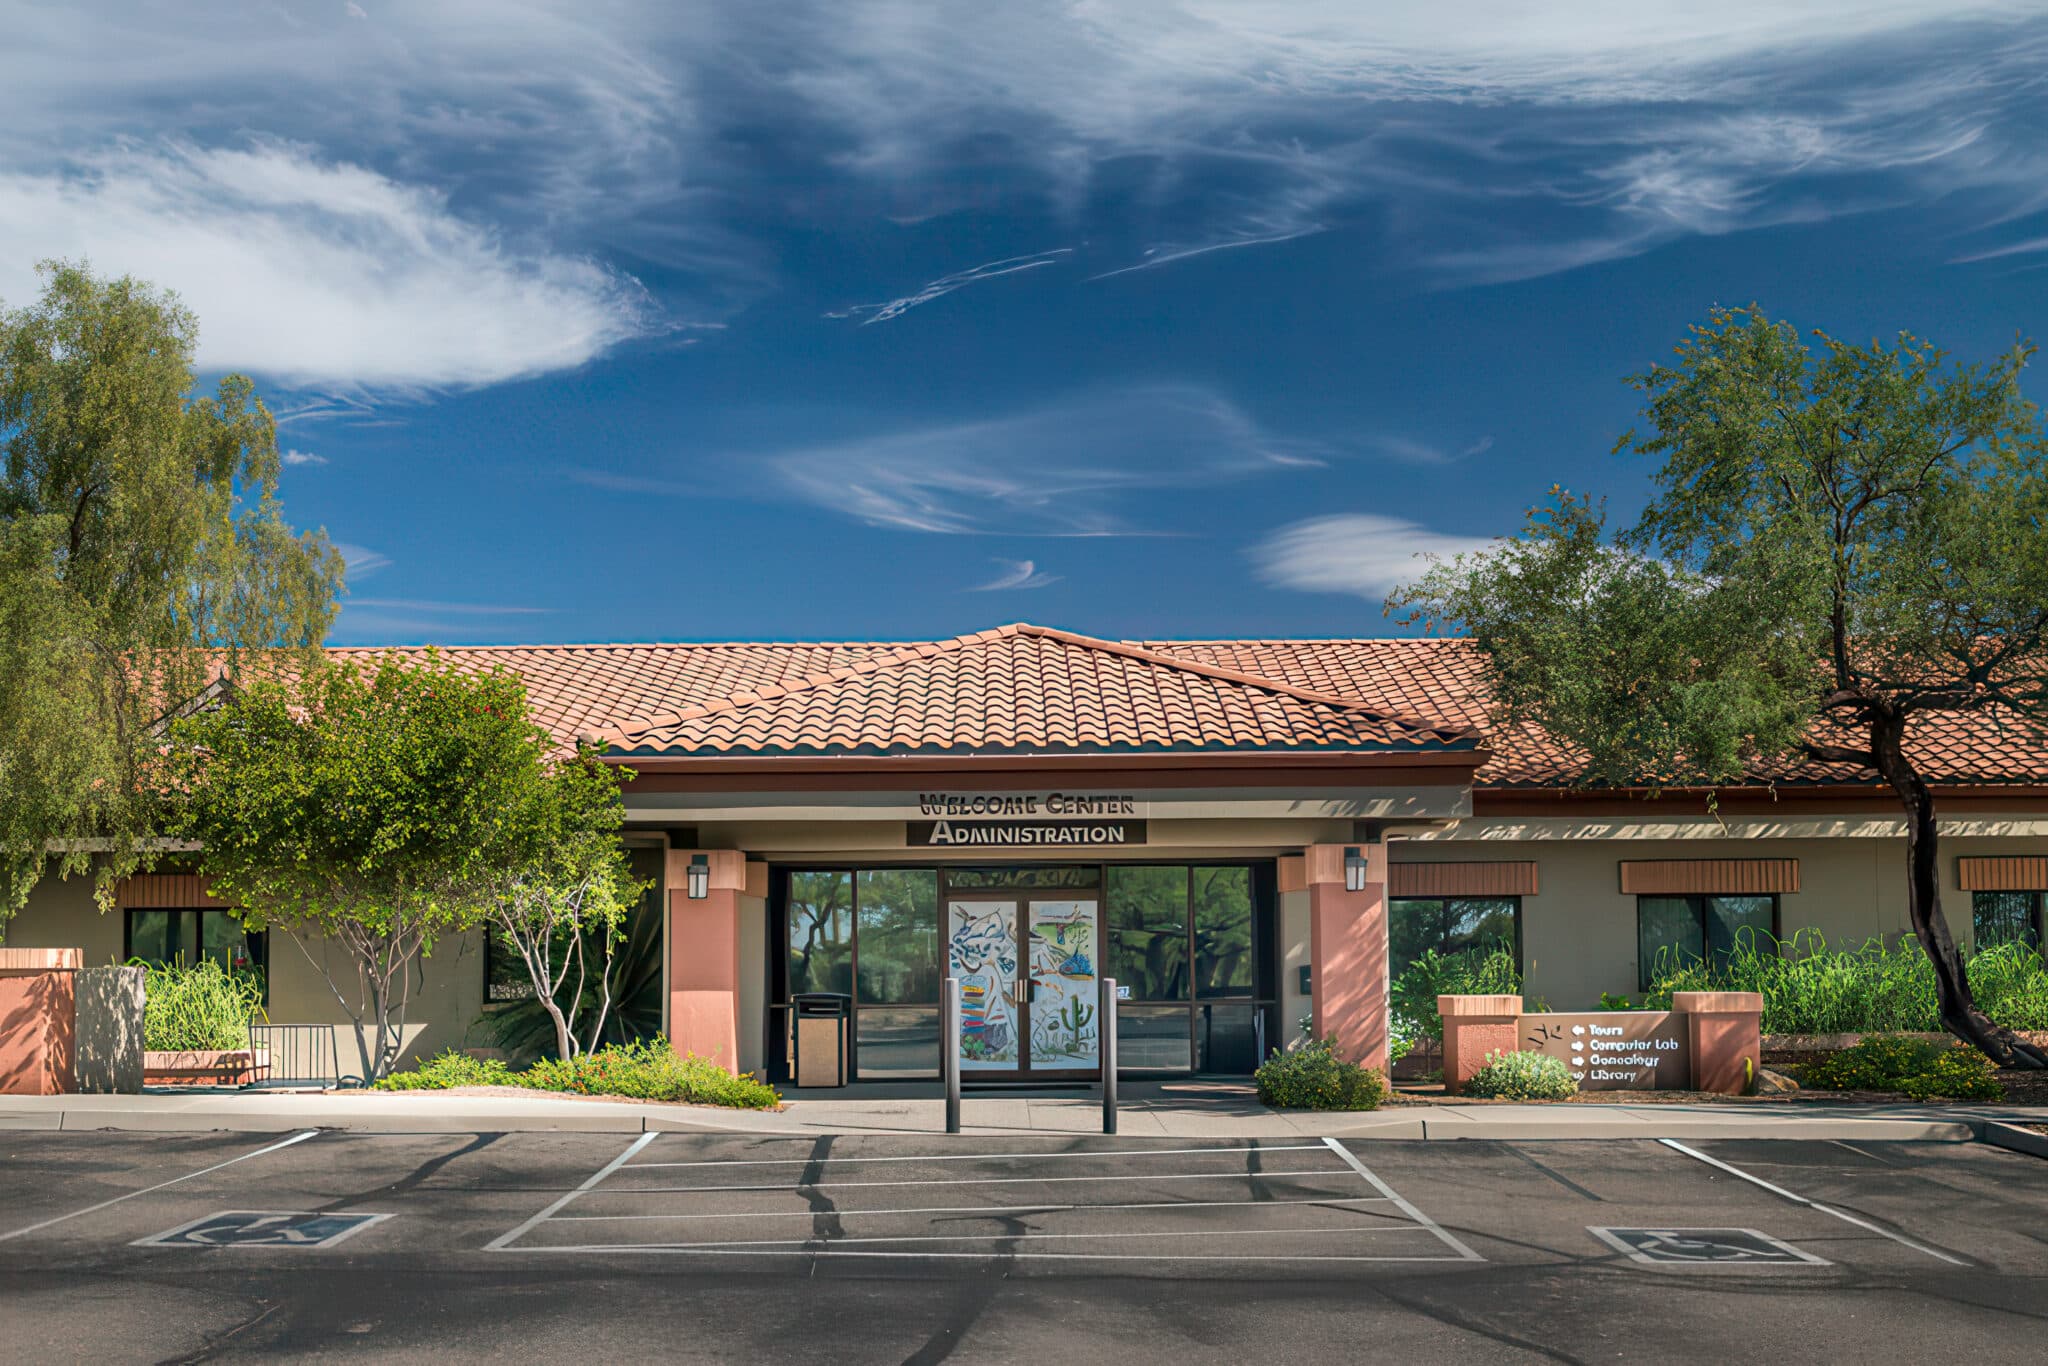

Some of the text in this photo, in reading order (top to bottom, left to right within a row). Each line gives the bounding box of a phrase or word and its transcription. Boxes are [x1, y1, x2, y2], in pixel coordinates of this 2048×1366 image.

[919, 792, 1135, 816] WELCOME CENTER
[929, 820, 1125, 844] ADMINISTRATION
[1589, 1024, 1623, 1035] Tours
[1655, 1038, 1679, 1050] Lab
[1591, 1070, 1636, 1082] Library
